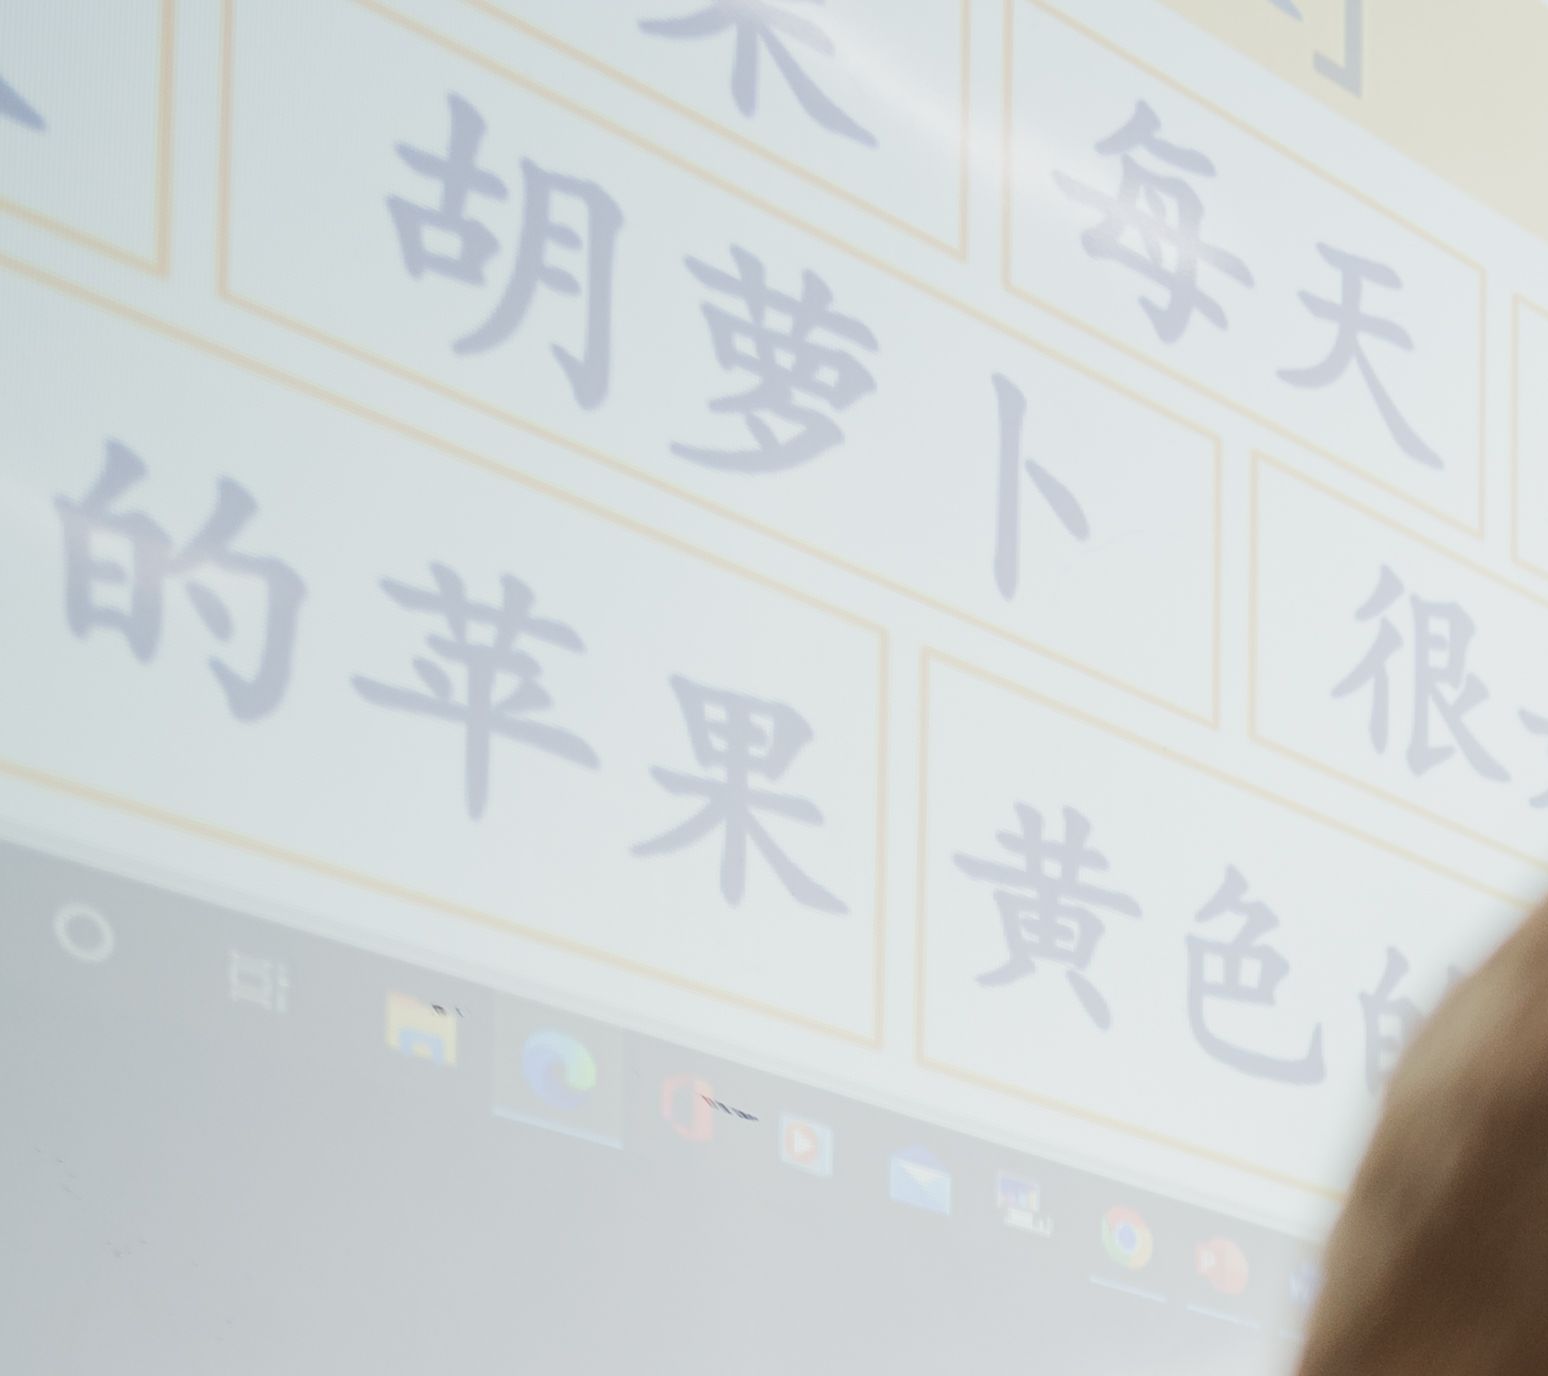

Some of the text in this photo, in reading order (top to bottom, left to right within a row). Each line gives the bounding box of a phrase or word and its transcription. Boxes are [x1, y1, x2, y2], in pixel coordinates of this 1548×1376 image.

[385, 90, 1090, 601] 胡萝卜
[1052, 98, 1443, 470] 每天
[52, 436, 850, 915] 的苹果
